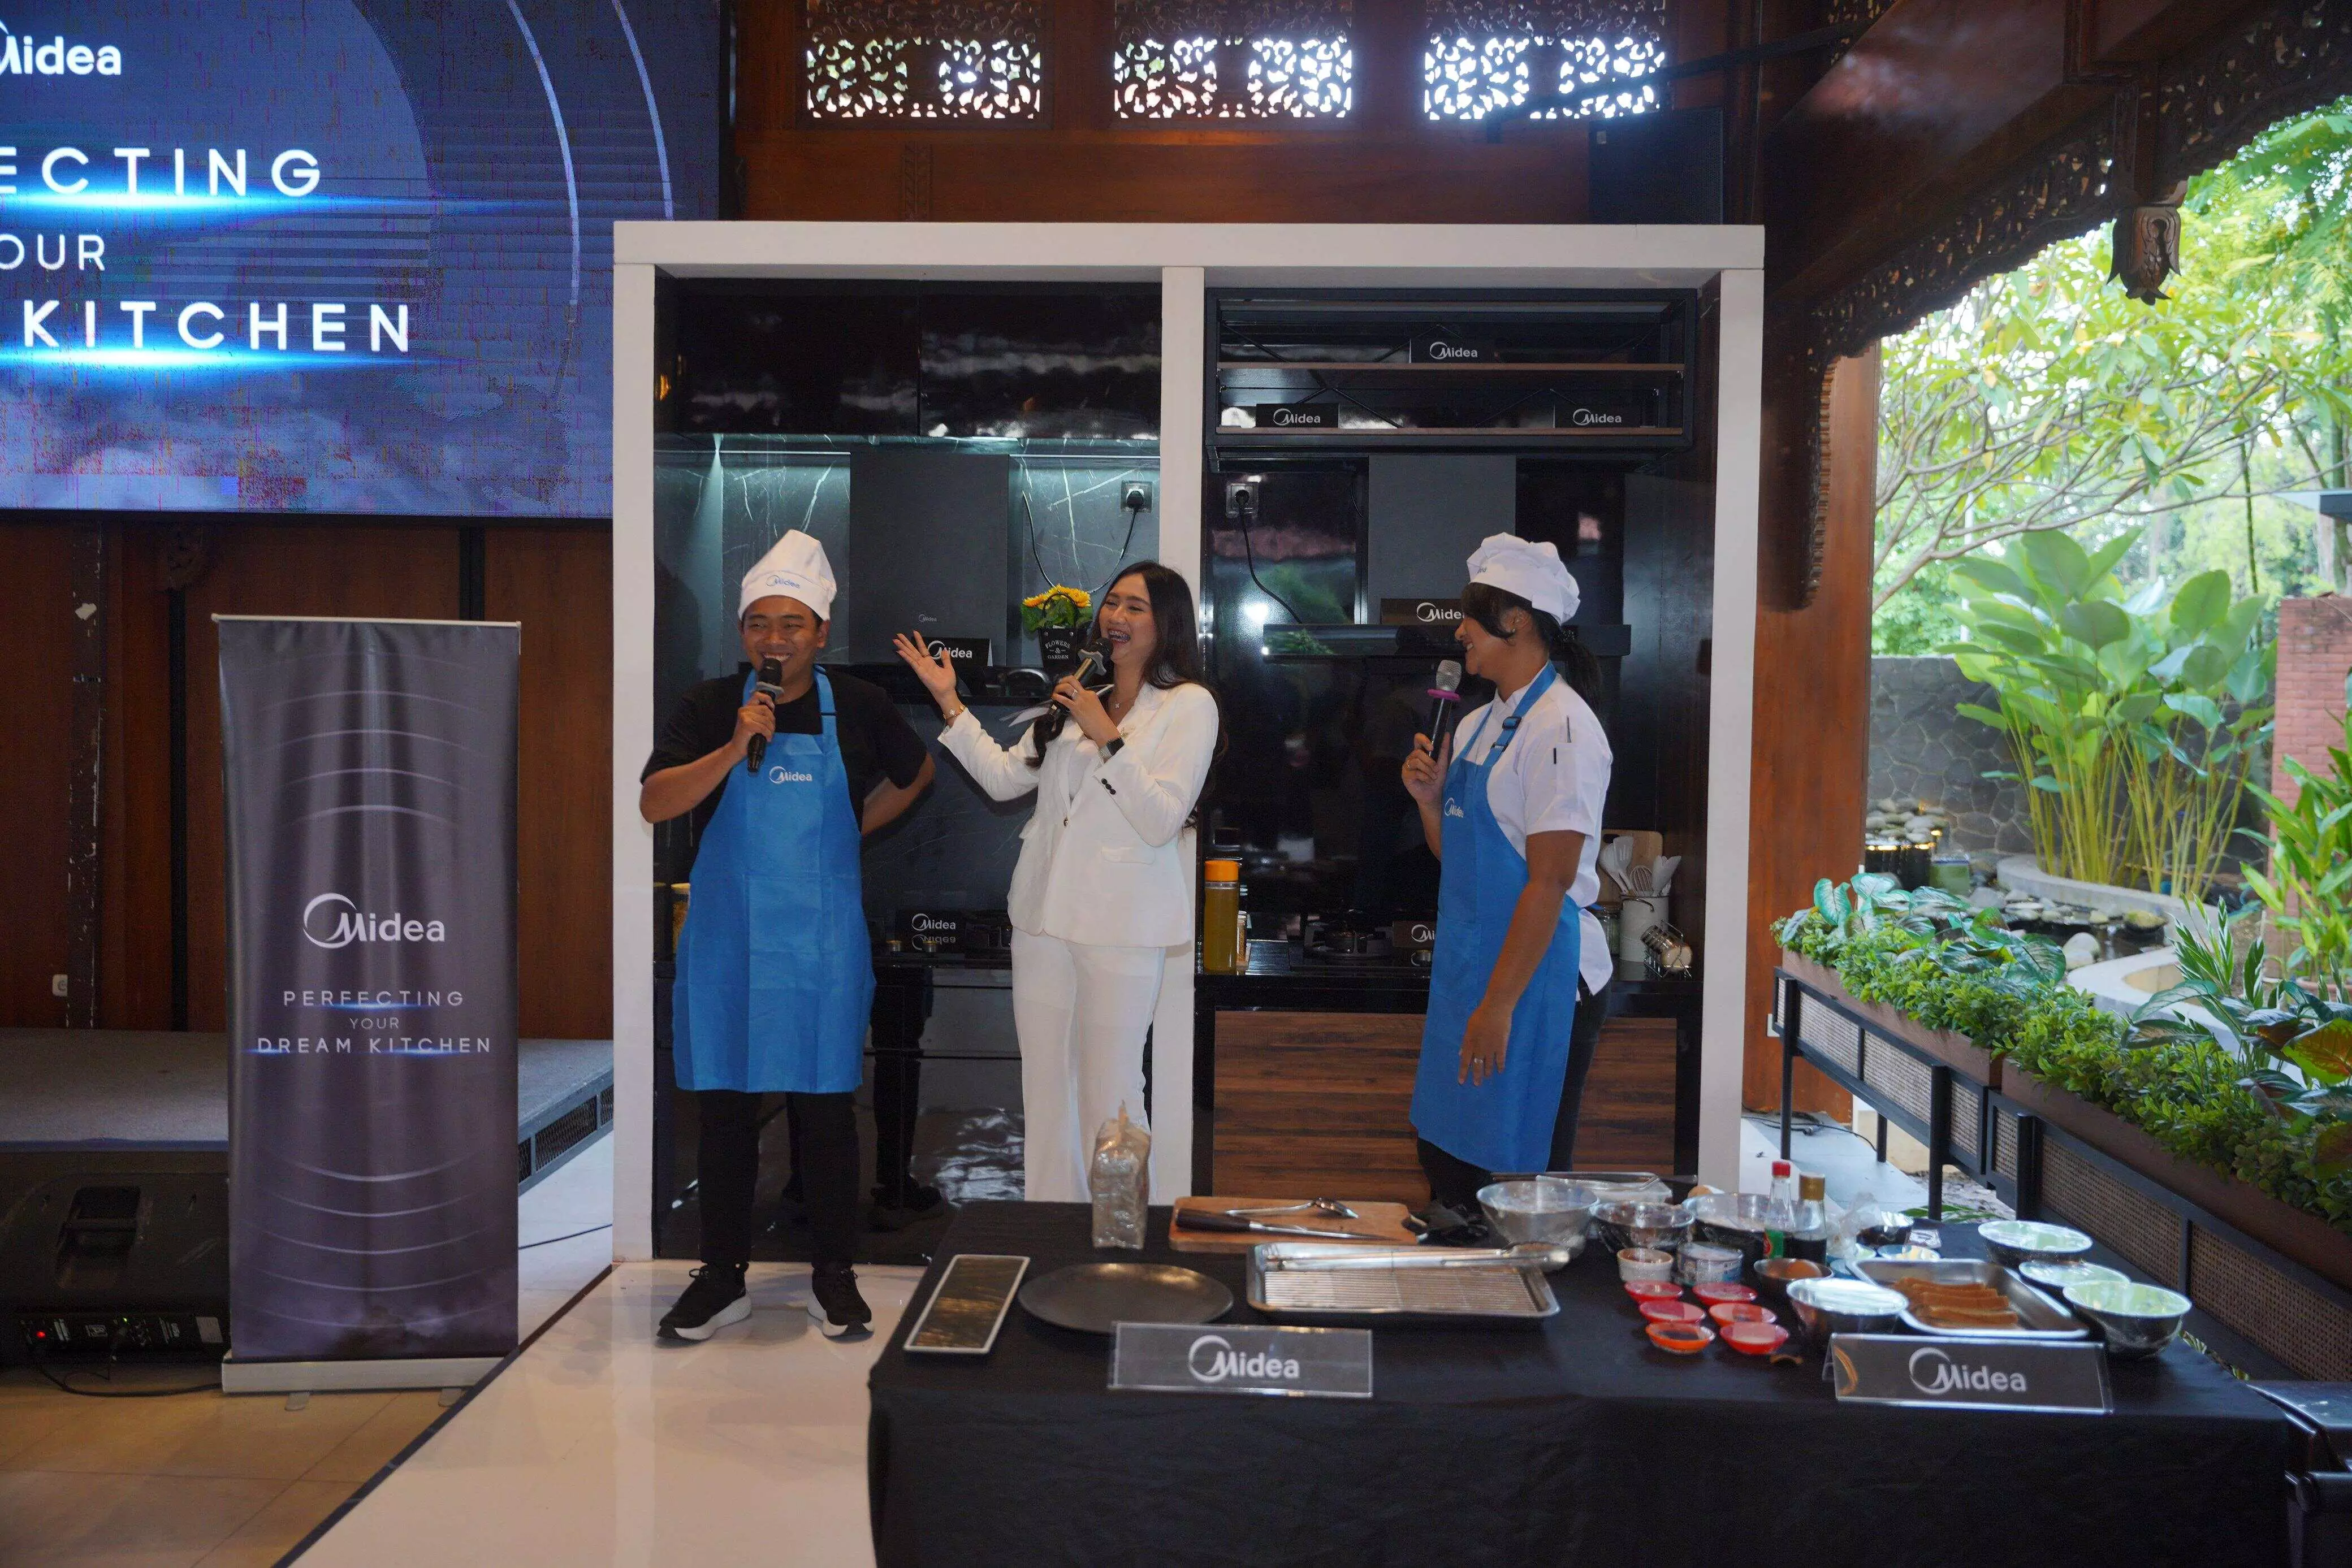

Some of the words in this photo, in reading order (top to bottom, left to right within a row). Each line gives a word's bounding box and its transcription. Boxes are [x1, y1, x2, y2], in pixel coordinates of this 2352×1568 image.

[0, 146, 321, 197] ECTING
[0, 233, 106, 271] OUR
[23, 300, 409, 352] KITCHEN
[1430, 341, 1478, 359] Midea
[1273, 408, 1321, 426] Midea
[1572, 408, 1622, 426] Midea
[766, 574, 801, 589] Midea
[918, 614, 937, 622] Midea
[1416, 602, 1464, 622] Mide
[1045, 639, 1070, 649] FLOWERS
[769, 766, 812, 784] Midea
[302, 893, 446, 948] Midea
[911, 913, 956, 931] Midea
[284, 991, 464, 1006] PERFECTING
[349, 1017, 400, 1029] YOUR
[257, 1038, 351, 1053] DREAM
[370, 1038, 490, 1053] KITCHEN
[1188, 1335, 1300, 1383] Midea
[1908, 1347, 2027, 1396] Midea
